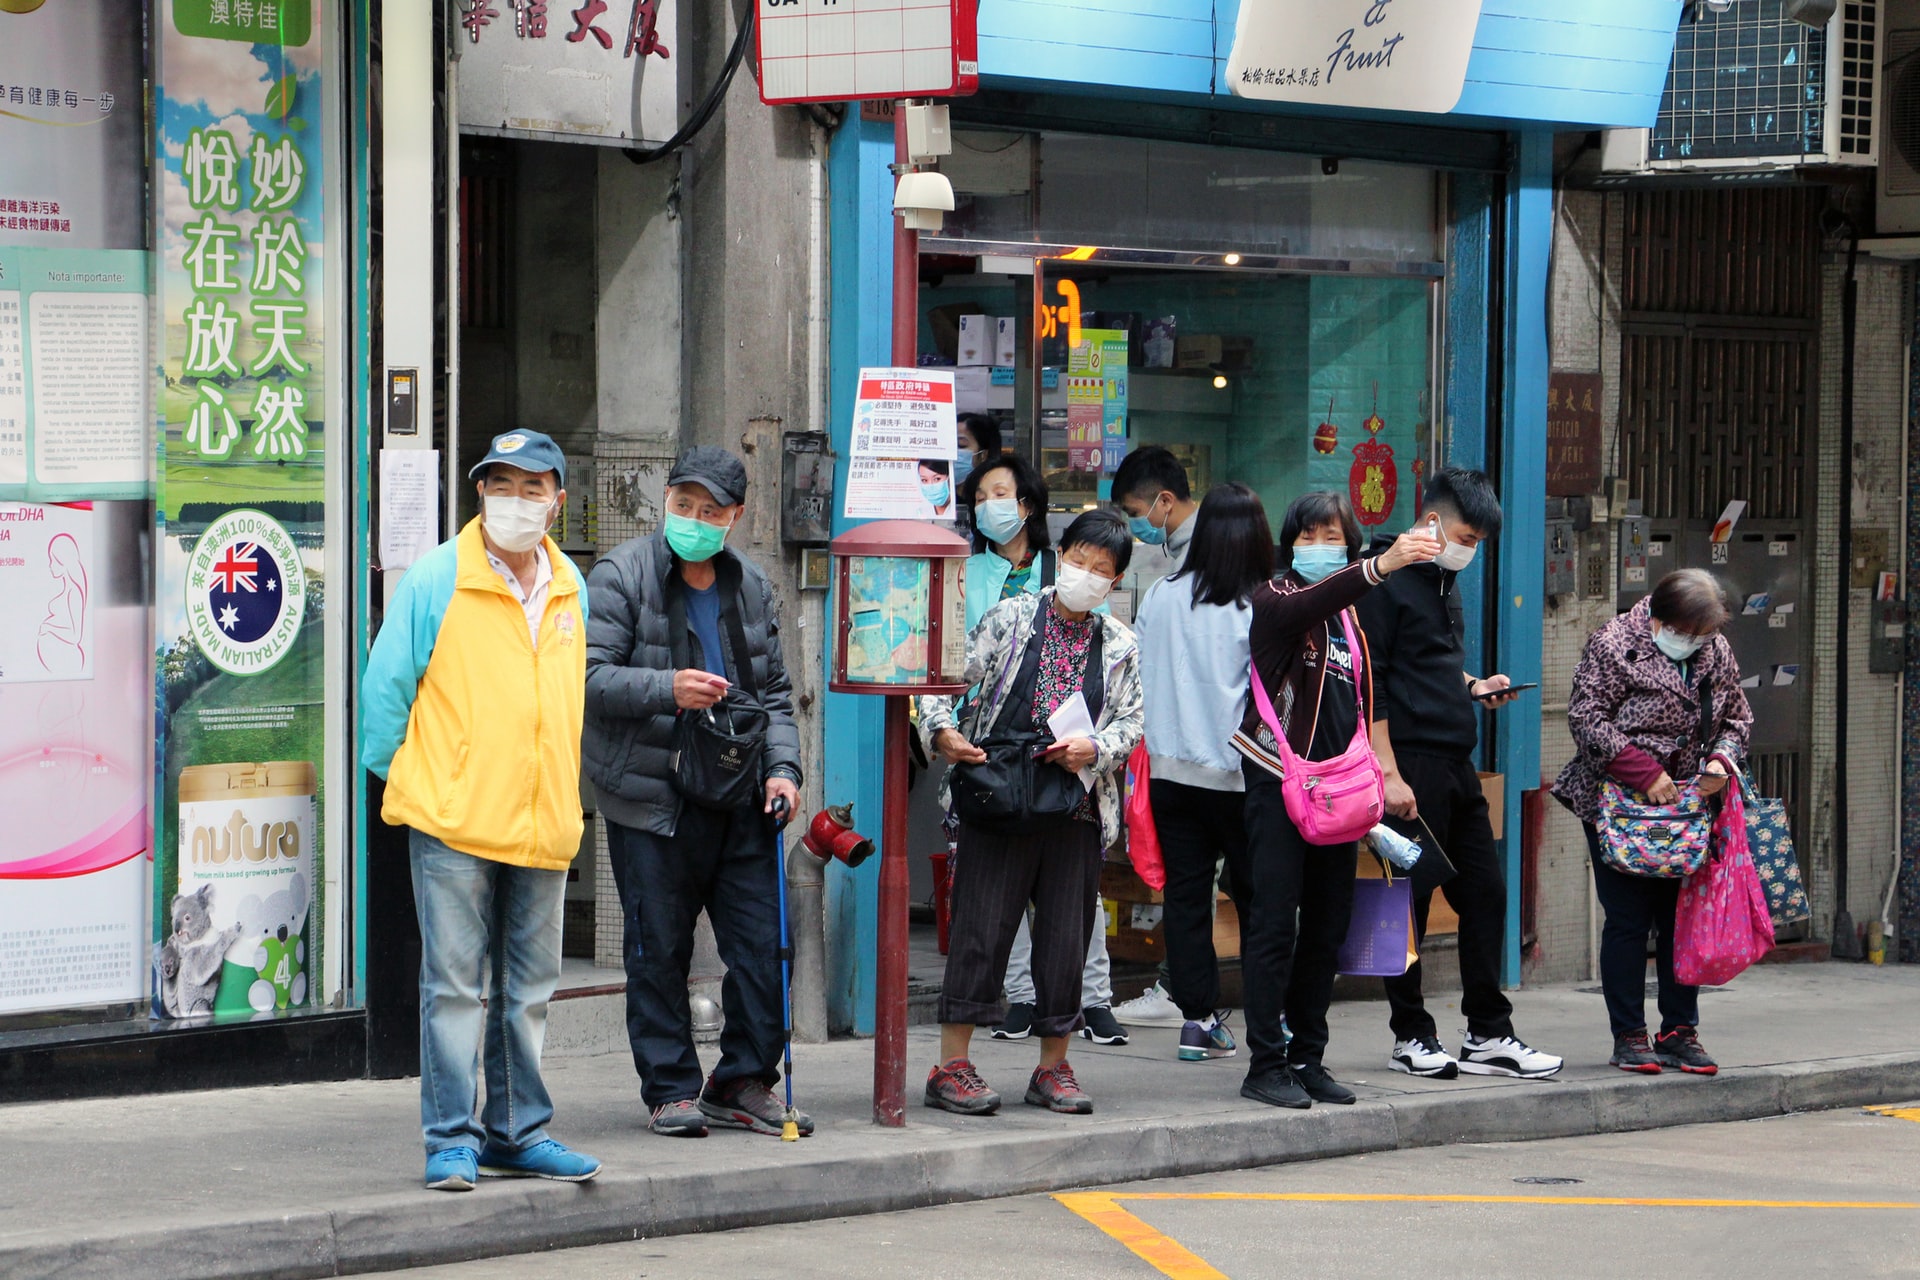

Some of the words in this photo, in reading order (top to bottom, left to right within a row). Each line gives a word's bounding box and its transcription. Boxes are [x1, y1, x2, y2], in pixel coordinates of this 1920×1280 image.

[209, 0, 277, 29] 澳特佳
[1326, 28, 1405, 84] Fruit
[48, 271, 71, 282] Nota
[73, 273, 125, 283] importante:
[18, 507, 44, 521] DHA
[1712, 543, 1728, 562] 3A
[193, 601, 222, 652] MADE
[221, 604, 298, 666] AUSTRALIAN
[191, 809, 300, 866] nutura
[245, 870, 270, 879] growing
[271, 869, 278, 877] up
[278, 866, 297, 875] formula
[274, 953, 291, 990] 4
